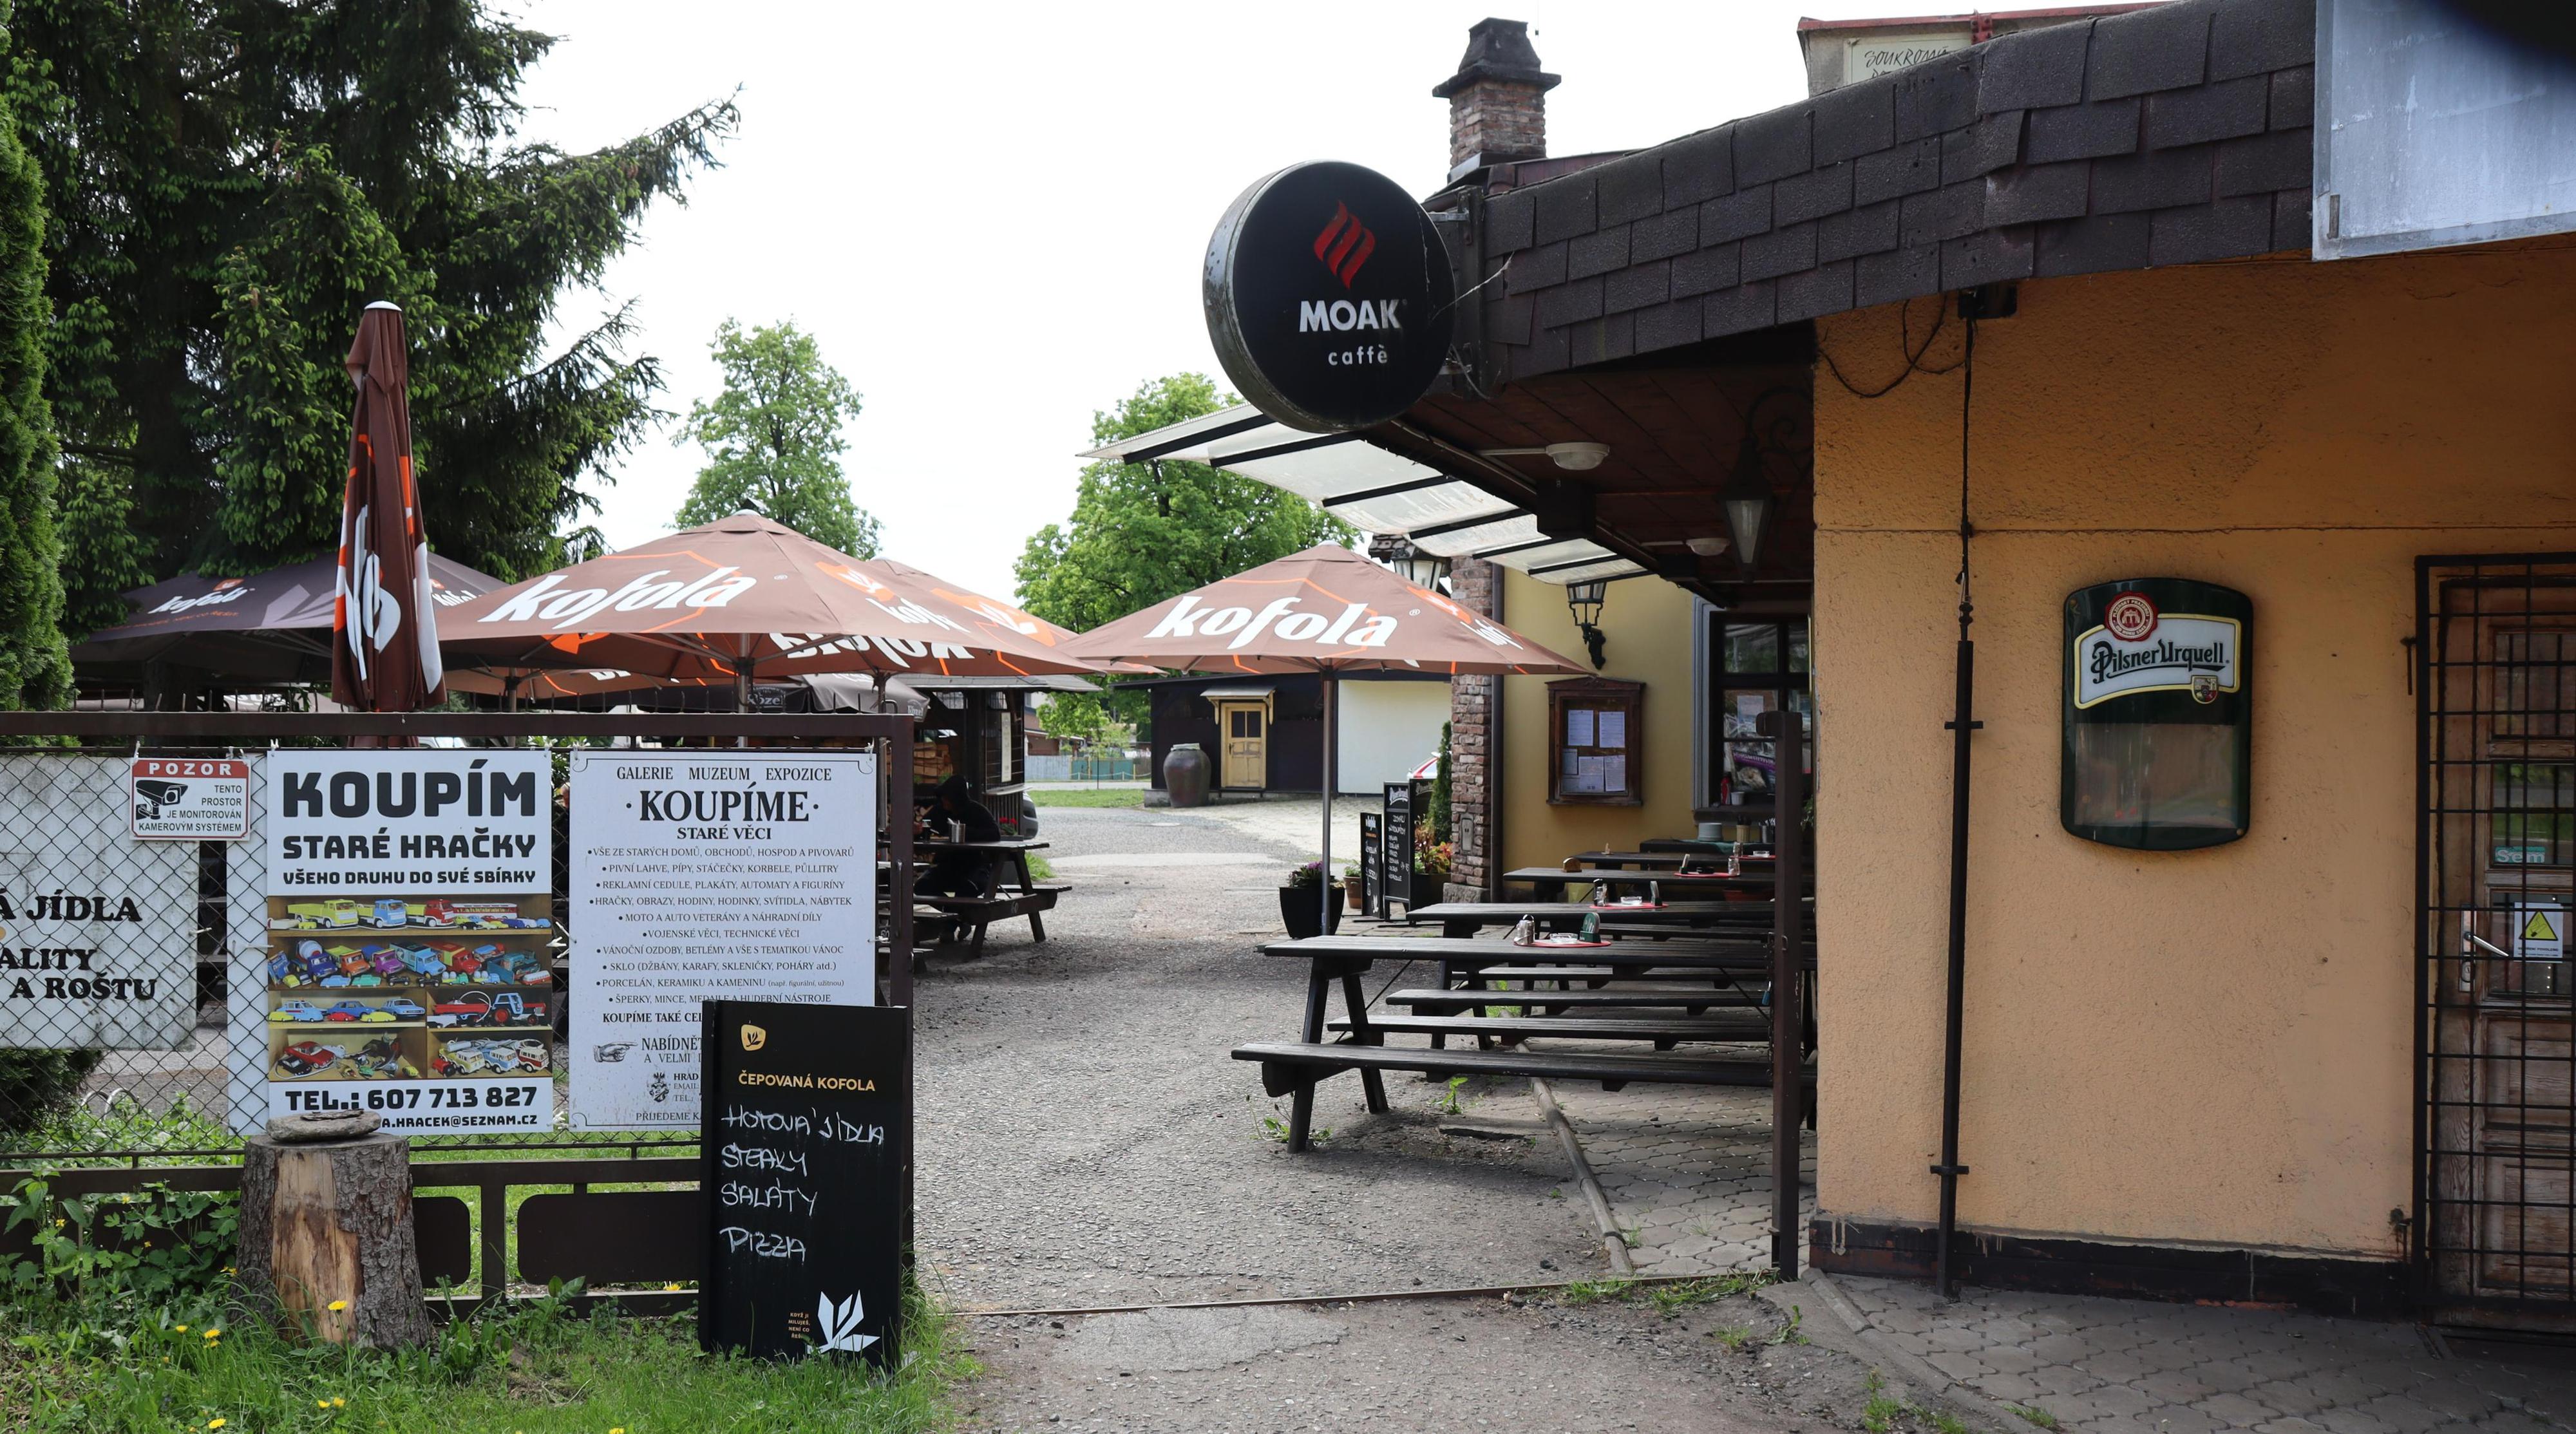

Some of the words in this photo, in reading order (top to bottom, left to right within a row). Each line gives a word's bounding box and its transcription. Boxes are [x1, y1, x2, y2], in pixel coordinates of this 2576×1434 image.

[1299, 299, 1400, 332] MOAK
[1328, 344, 1387, 366] caffè
[477, 566, 757, 630] kofola
[1143, 596, 1398, 650] kofola
[2090, 641, 2159, 684] Pilsner
[2158, 639, 2224, 672] Urquell
[149, 760, 240, 776] POZOR
[616, 766, 674, 780] GALERIE
[688, 767, 750, 781] MUZEUM
[765, 767, 832, 782] EXPOZICE
[214, 784, 242, 793] TENTO
[283, 759, 536, 818] KOUPÍM
[201, 797, 242, 806] PROSTOR
[639, 779, 810, 822] KOUPÍME
[167, 809, 177, 818] JE
[179, 809, 242, 819] MONITOROVÁN
[138, 821, 193, 831] KAMEROVÝM
[195, 822, 242, 832] SYSTÉMEM
[676, 824, 729, 840] STARÉ
[732, 824, 772, 840] VĚCI
[283, 827, 390, 859] STARÉ
[401, 827, 536, 859] HRAČKY
[592, 846, 611, 856] VŠE
[612, 847, 625, 856] ZE
[626, 845, 668, 856] STARÝCH
[671, 845, 703, 858] DOMŮ,
[705, 845, 755, 858] OBCHODŮ,
[757, 848, 797, 857] HOSPOD
[799, 848, 806, 857] A
[808, 846, 854, 857] PIVOVARŮ
[283, 868, 340, 885] VŠEHO
[345, 871, 405, 884] DRUHU
[410, 871, 433, 884] DO
[437, 867, 469, 883] SVÉ
[473, 867, 536, 883] SBÍRKY
[609, 862, 635, 873] PIVNÍ
[636, 864, 670, 874] LAHVE,
[672, 862, 694, 874] PÍPY,
[696, 862, 745, 874] STÁČEČKY,
[748, 864, 793, 874] KORBELE,
[795, 862, 838, 873] PŮLLITRY
[602, 879, 651, 889] REKLAMNÍ
[652, 880, 692, 891] CEDULE,
[695, 878, 738, 890] PLAKÁTY,
[740, 880, 791, 889] AUTOMATY
[792, 880, 800, 889] A
[801, 879, 845, 889] FIGURÍNY
[26, 889, 143, 922] JÍDLA
[595, 895, 634, 906] HRAČKY,
[636, 897, 676, 907] OBRAZY,
[677, 897, 715, 907] HODINY,
[717, 897, 761, 907] HODINKY,
[763, 895, 808, 906] SVÍTIDLA,
[810, 895, 852, 905] NÁBYTEK
[625, 913, 654, 922] MOTO
[656, 913, 663, 922] A
[664, 913, 691, 922] AUTO
[692, 911, 741, 922] VETERÁNY
[743, 913, 750, 922] A
[752, 911, 800, 922] NÁHRADNÍ
[802, 911, 822, 921] DÍLY
[647, 927, 696, 938] VOJENSKÉ
[697, 928, 721, 939] VĚCI,
[723, 927, 777, 938] TECHNICKÉ
[778, 927, 799, 938] VĚCI
[603, 944, 645, 955] VÁNOČNÍ
[645, 945, 683, 956] OZDOBY,
[685, 946, 726, 954] BETLÉMY
[727, 946, 734, 954] A
[735, 944, 752, 954] VŠE
[753, 945, 759, 954] S
[761, 945, 811, 954] TEMATIKOU
[813, 943, 844, 954] VÁNOC
[610, 962, 636, 971] SKLO
[637, 960, 680, 972] (DŽBÁNY,
[682, 962, 720, 972] KARAFY,
[721, 960, 774, 971] SKLENIČKY,
[776, 959, 815, 970] POHÁRY
[816, 961, 837, 972] atd.)
[9, 976, 35, 999] A
[44, 972, 157, 1001] ROŠTU
[602, 976, 655, 988] PORCELÁN,
[658, 978, 705, 987] KERAMIKU
[707, 978, 715, 987] A
[716, 978, 766, 987] KAMENINU
[615, 994, 652, 1005] ŠPERKY,
[654, 995, 687, 1005] MINCE,
[784, 992, 831, 1002] NÁSTROJE
[602, 1010, 652, 1023] KOUPÍME
[654, 1010, 682, 1023] TAKÉ
[643, 1053, 652, 1063] A
[658, 1053, 691, 1063] VELMI
[673, 1072, 699, 1081] HRAD
[738, 1070, 814, 1088] ČEPOVANÁ
[817, 1077, 876, 1092] KOFOLA
[285, 1091, 359, 1111] TEL.:
[367, 1089, 421, 1110] 607
[428, 1088, 478, 1108] 713
[486, 1086, 537, 1108] 827
[636, 1111, 691, 1121] PŘIJEDEME
[721, 1104, 817, 1135] HOTOVÁ
[721, 1142, 807, 1177] STEAKY
[721, 1177, 818, 1216] SALÁTY
[719, 1226, 806, 1263] PIZZA
